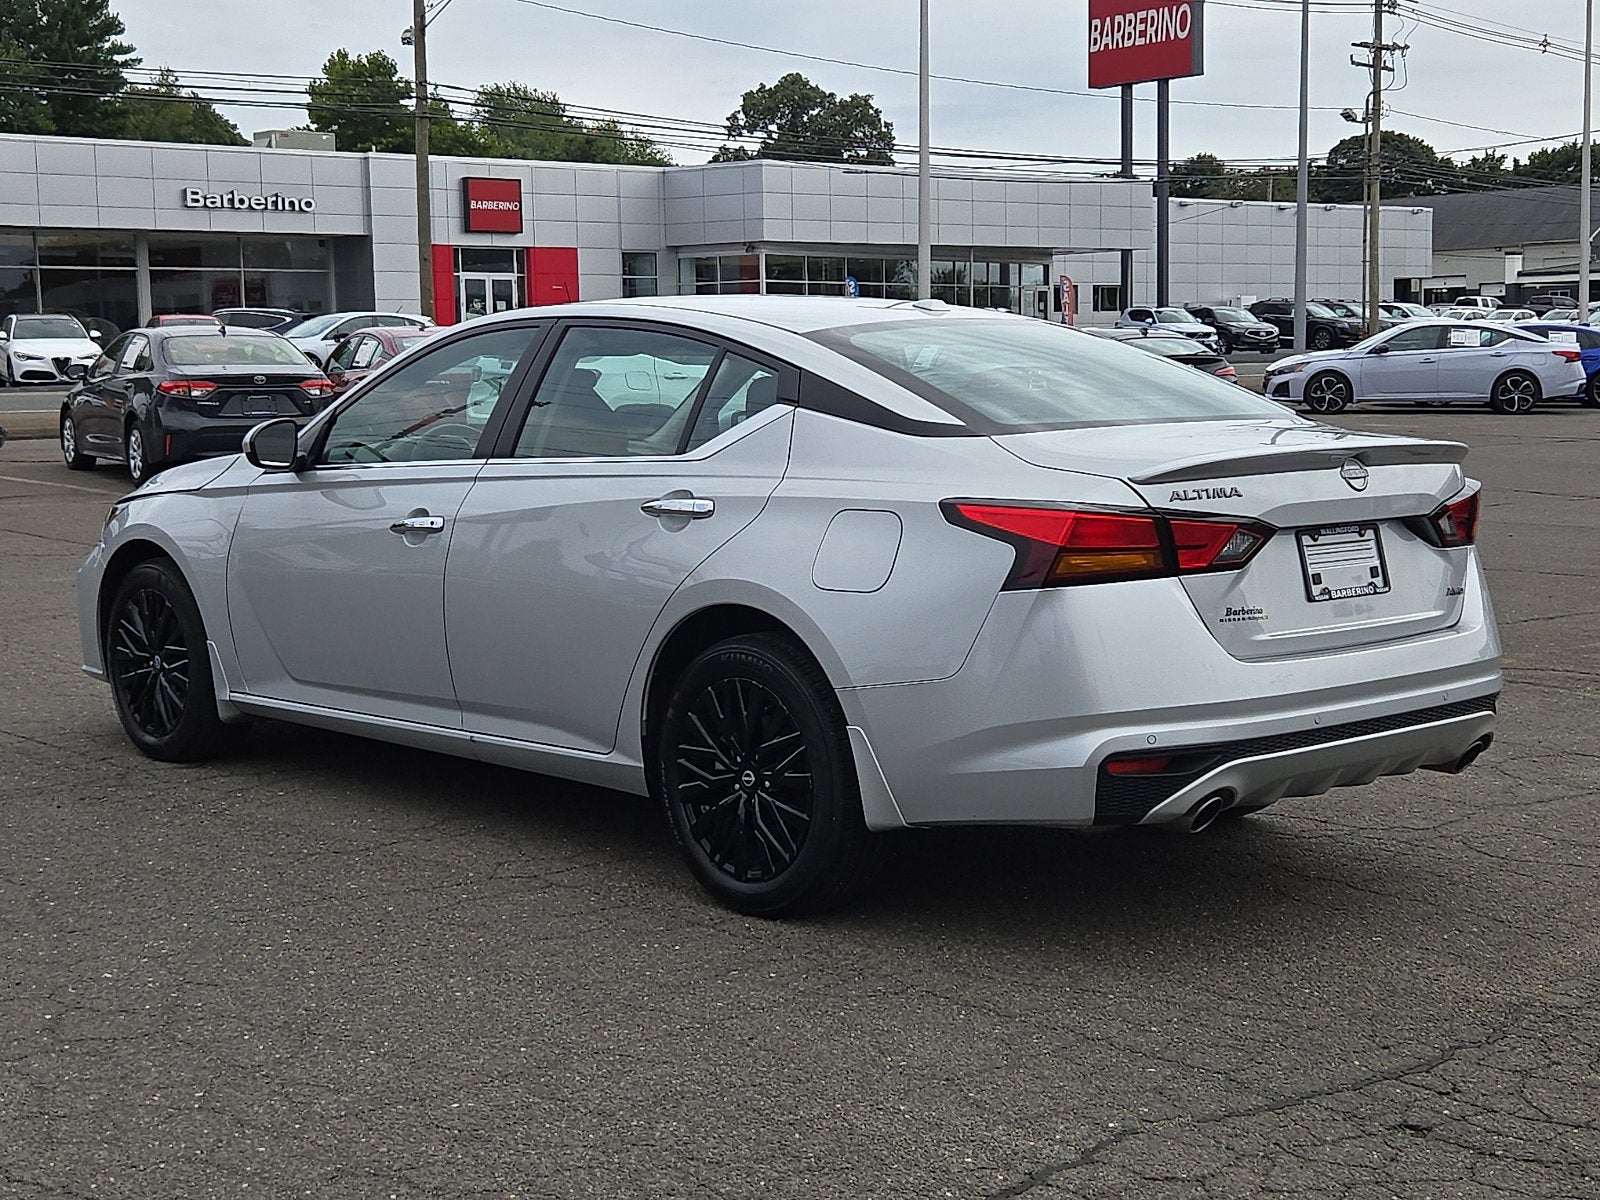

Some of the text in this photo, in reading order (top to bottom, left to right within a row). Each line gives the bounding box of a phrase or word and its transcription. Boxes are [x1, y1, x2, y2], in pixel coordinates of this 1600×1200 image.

[1089, 3, 1192, 53] BARBERINO
[184, 187, 316, 212] Barberino
[470, 200, 520, 211] BARBERINO
[1169, 486, 1243, 502] ALTIMA
[1320, 525, 1360, 535] WALLINGFORD
[1331, 585, 1374, 599] BARBERINO
[1225, 605, 1263, 617] Barberino
